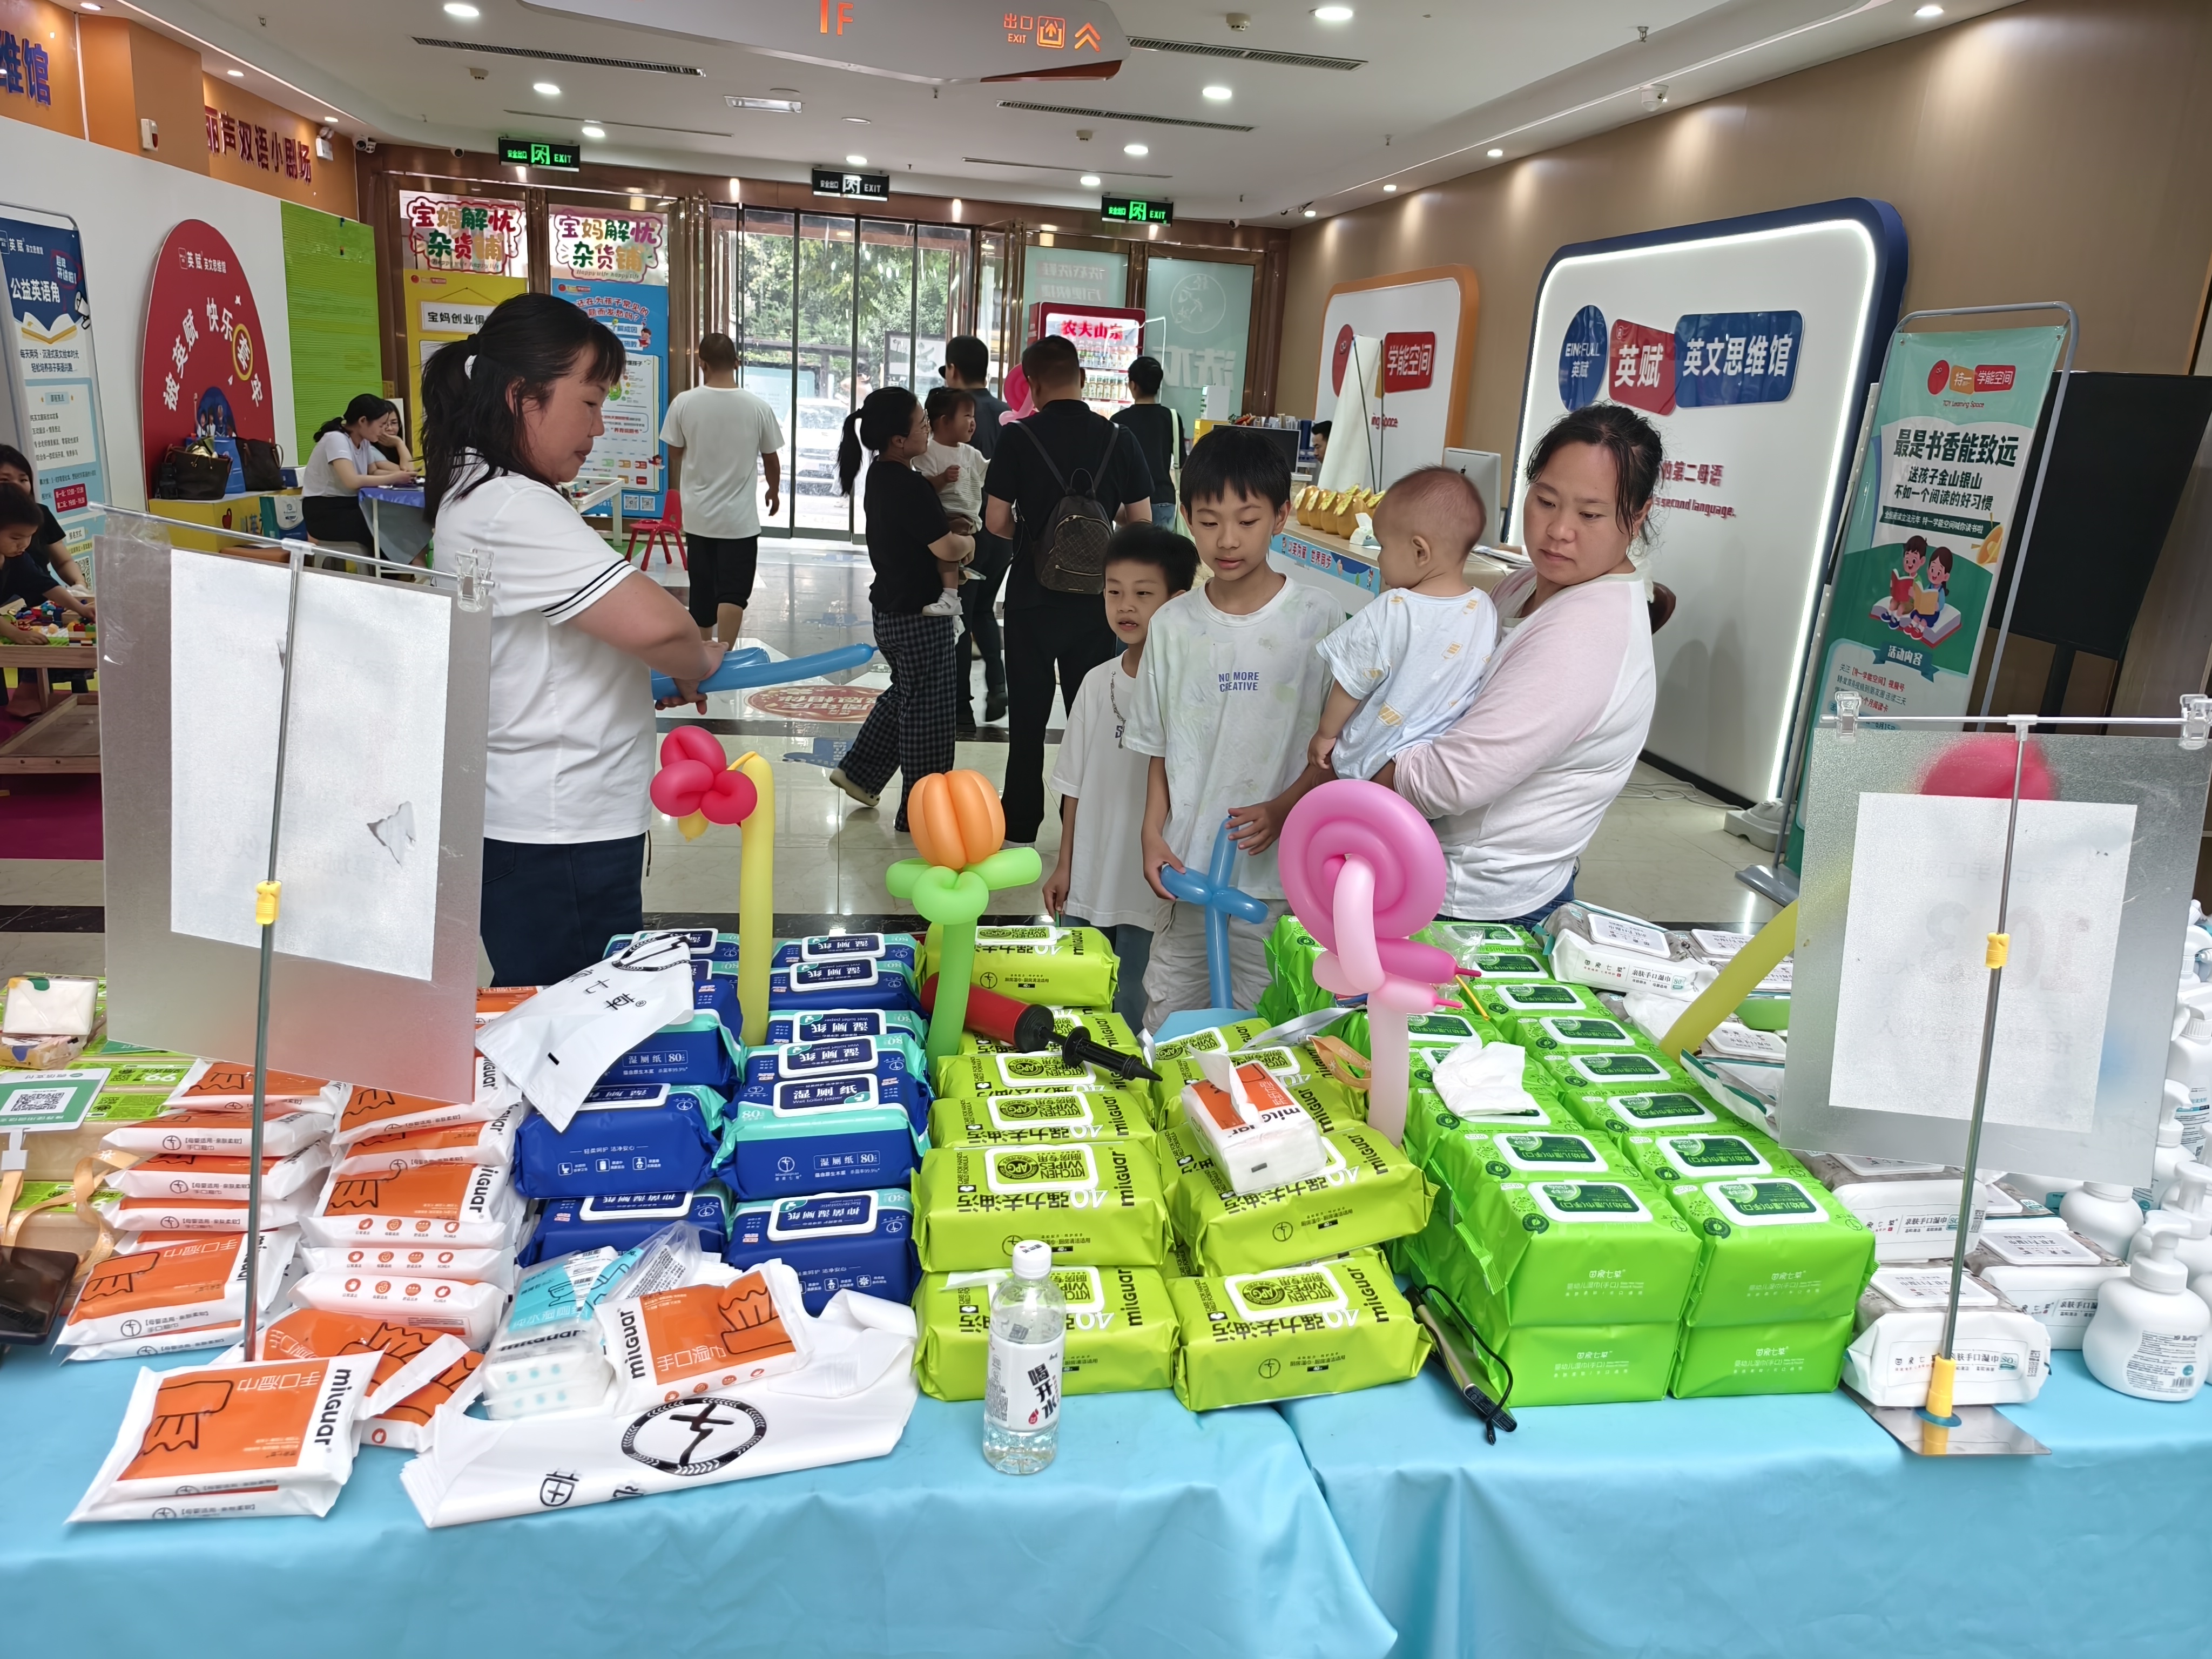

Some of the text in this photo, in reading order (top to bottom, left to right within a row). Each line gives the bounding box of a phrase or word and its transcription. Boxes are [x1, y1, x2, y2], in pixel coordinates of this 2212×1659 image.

[1004, 13, 1033, 31] 出口
[1008, 33, 1027, 44] EXIT
[554, 153, 572, 163] EXIT
[864, 184, 881, 193] EXIT
[412, 204, 516, 233] 宝妈解忧
[1149, 211, 1166, 220] EXIT
[558, 217, 657, 244] 宝妈解忧
[428, 231, 502, 261] 杂货铺
[187, 251, 203, 270] 英赋
[573, 241, 645, 271] 杂货铺
[11, 278, 60, 303] 公益英语角
[1386, 344, 1432, 376] 学能空间
[1614, 334, 1792, 388] 英赋 英文思维馆
[1571, 361, 1590, 378] 英赋
[1977, 371, 2013, 386] 学能空间
[1893, 428, 2019, 467] 最是书香能致远
[1908, 466, 1982, 490] 送孩子金山银山
[1661, 496, 1691, 511] second
[1894, 484, 1993, 511] 不如一个阅读的好习惯
[1888, 645, 1923, 666] 活动内容
[1219, 672, 1259, 682] NO MORE
[1220, 682, 1258, 692] CREATIVE
[1631, 969, 1671, 982] 亲肤手口湿巾
[811, 1022, 868, 1033] 湿厕纸
[629, 1053, 682, 1064] 湿厕纸 80
[799, 1048, 859, 1062] 湿厕纸
[793, 1084, 857, 1100] 湿厕纸
[742, 1110, 761, 1118] 80
[1037, 1103, 1079, 1111] WIPES
[1039, 1109, 1081, 1117] KITCHEN
[967, 1127, 1070, 1144] 强力去油污
[820, 1154, 873, 1166] 湿厕纸 80
[1038, 1153, 1082, 1162] 厨房专用
[1006, 1163, 1028, 1174] APG
[1040, 1161, 1083, 1171] WIPES
[1041, 1169, 1085, 1179] KITCHEN
[888, 1193, 906, 1202] 80
[1224, 1166, 1359, 1214] 40 强力去油污
[957, 1189, 1109, 1213] 40 强力去油污
[787, 1207, 860, 1220] 抑菌湿厕纸
[1905, 1217, 1947, 1226] 亲肤手口湿巾
[164, 1239, 238, 1258] 手口湿巾
[1279, 1273, 1324, 1285] 厨房专用
[1251, 1286, 1276, 1298] APG
[1283, 1281, 1330, 1294] WIPES
[1290, 1289, 1334, 1303] KITCHEN
[1074, 1311, 1115, 1330] 40
[1212, 1309, 1359, 1342] 40 强力去油污
[657, 1345, 726, 1372] 手口湿巾
[237, 1371, 321, 1392] 手口湿巾
[1028, 1363, 1058, 1419] 喝开水
